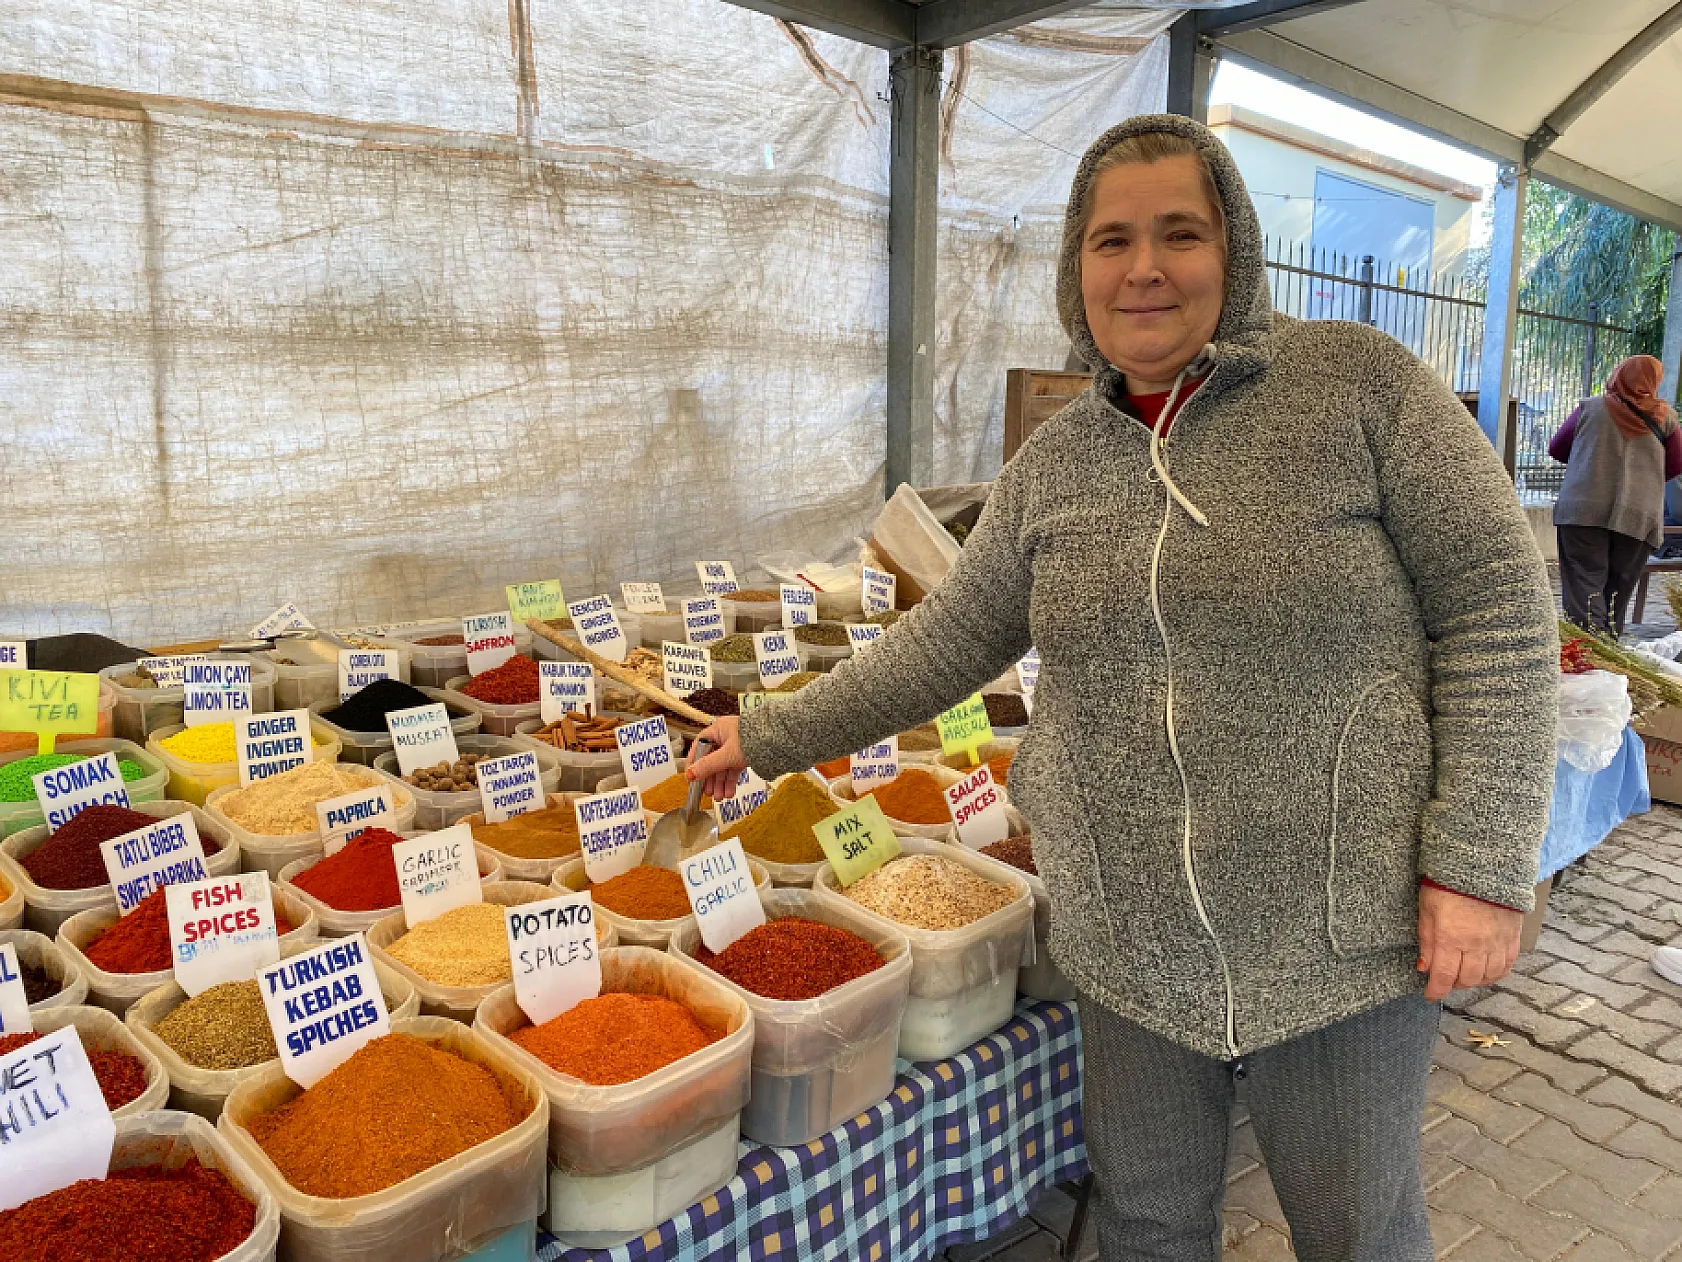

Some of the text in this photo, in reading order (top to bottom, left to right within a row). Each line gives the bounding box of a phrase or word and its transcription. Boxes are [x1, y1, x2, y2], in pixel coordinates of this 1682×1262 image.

[580, 612, 614, 630] GINGER
[465, 635, 515, 654] SAFFRON
[585, 627, 621, 645] INGWER
[183, 665, 251, 689] LIMON ÇAYI
[665, 660, 707, 677] CLAUVES
[759, 655, 799, 677] OREGANO
[28, 703, 79, 721] TEA
[183, 691, 249, 711] LIMON TEA
[247, 716, 297, 739] GINGER
[618, 718, 667, 748] CHICKEN
[246, 737, 304, 761] INGWER
[630, 744, 669, 772] SPICES
[43, 757, 116, 799] SOMAK
[485, 770, 536, 794] CINNAMON
[949, 768, 989, 805] SALAD
[326, 796, 387, 828] PAPRICA
[493, 787, 536, 810] POWDER
[955, 788, 997, 826] SPICES
[834, 814, 864, 839] MIX
[148, 826, 188, 858] BİBER
[842, 832, 875, 860] SALT
[152, 857, 209, 886] PAPRIKA
[402, 844, 462, 874] GARLIC
[686, 850, 737, 888] CHILI
[190, 882, 243, 911] FISH
[695, 877, 748, 916] GARLIC
[183, 908, 261, 943] SPICES
[510, 904, 592, 941] POTATO
[264, 941, 364, 995] TURKISH
[519, 938, 594, 975] SPICES
[283, 973, 363, 1024] KEBAB
[286, 999, 380, 1059] SPICHES
